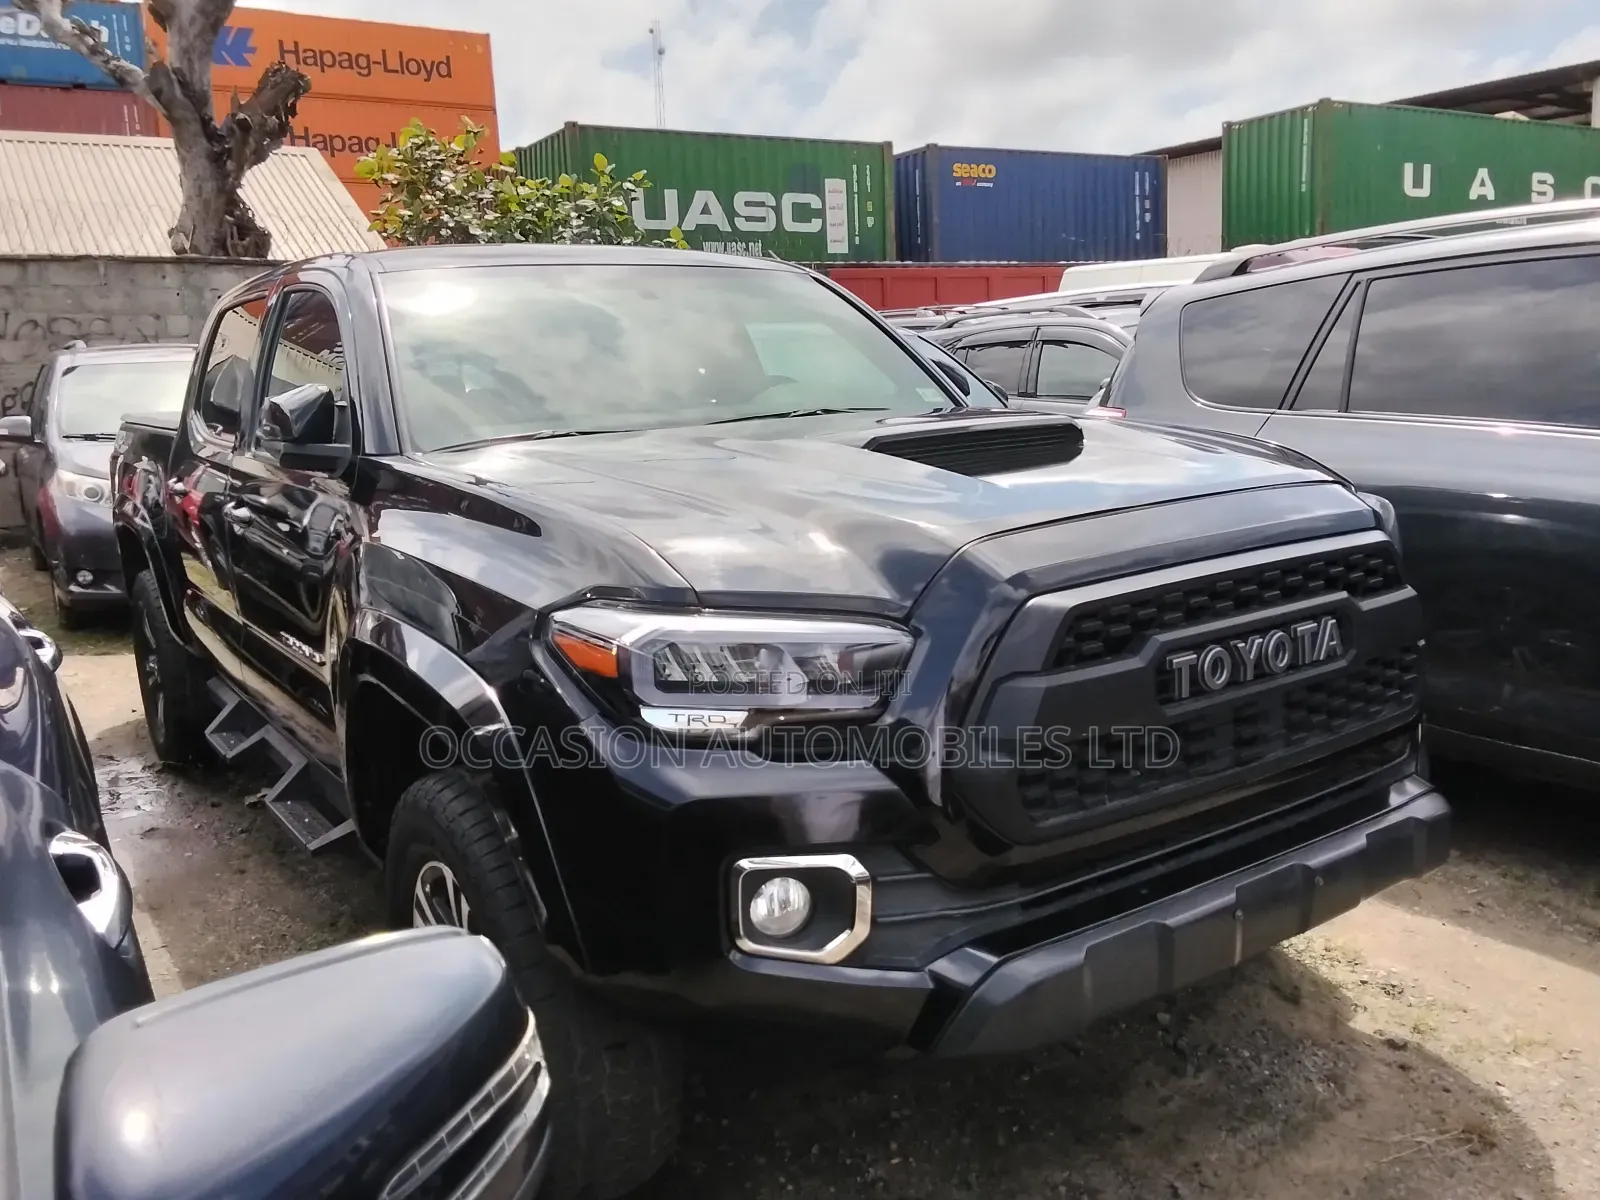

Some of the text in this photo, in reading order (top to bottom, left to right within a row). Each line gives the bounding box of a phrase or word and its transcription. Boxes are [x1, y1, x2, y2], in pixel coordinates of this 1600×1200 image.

[278, 39, 452, 82] Hapag-Lloyd
[952, 163, 996, 178] seaco
[631, 187, 823, 233] UASC
[703, 240, 762, 257] www.uasc.net
[1166, 616, 1344, 698] TOYOTA
[668, 713, 738, 728] TRD
